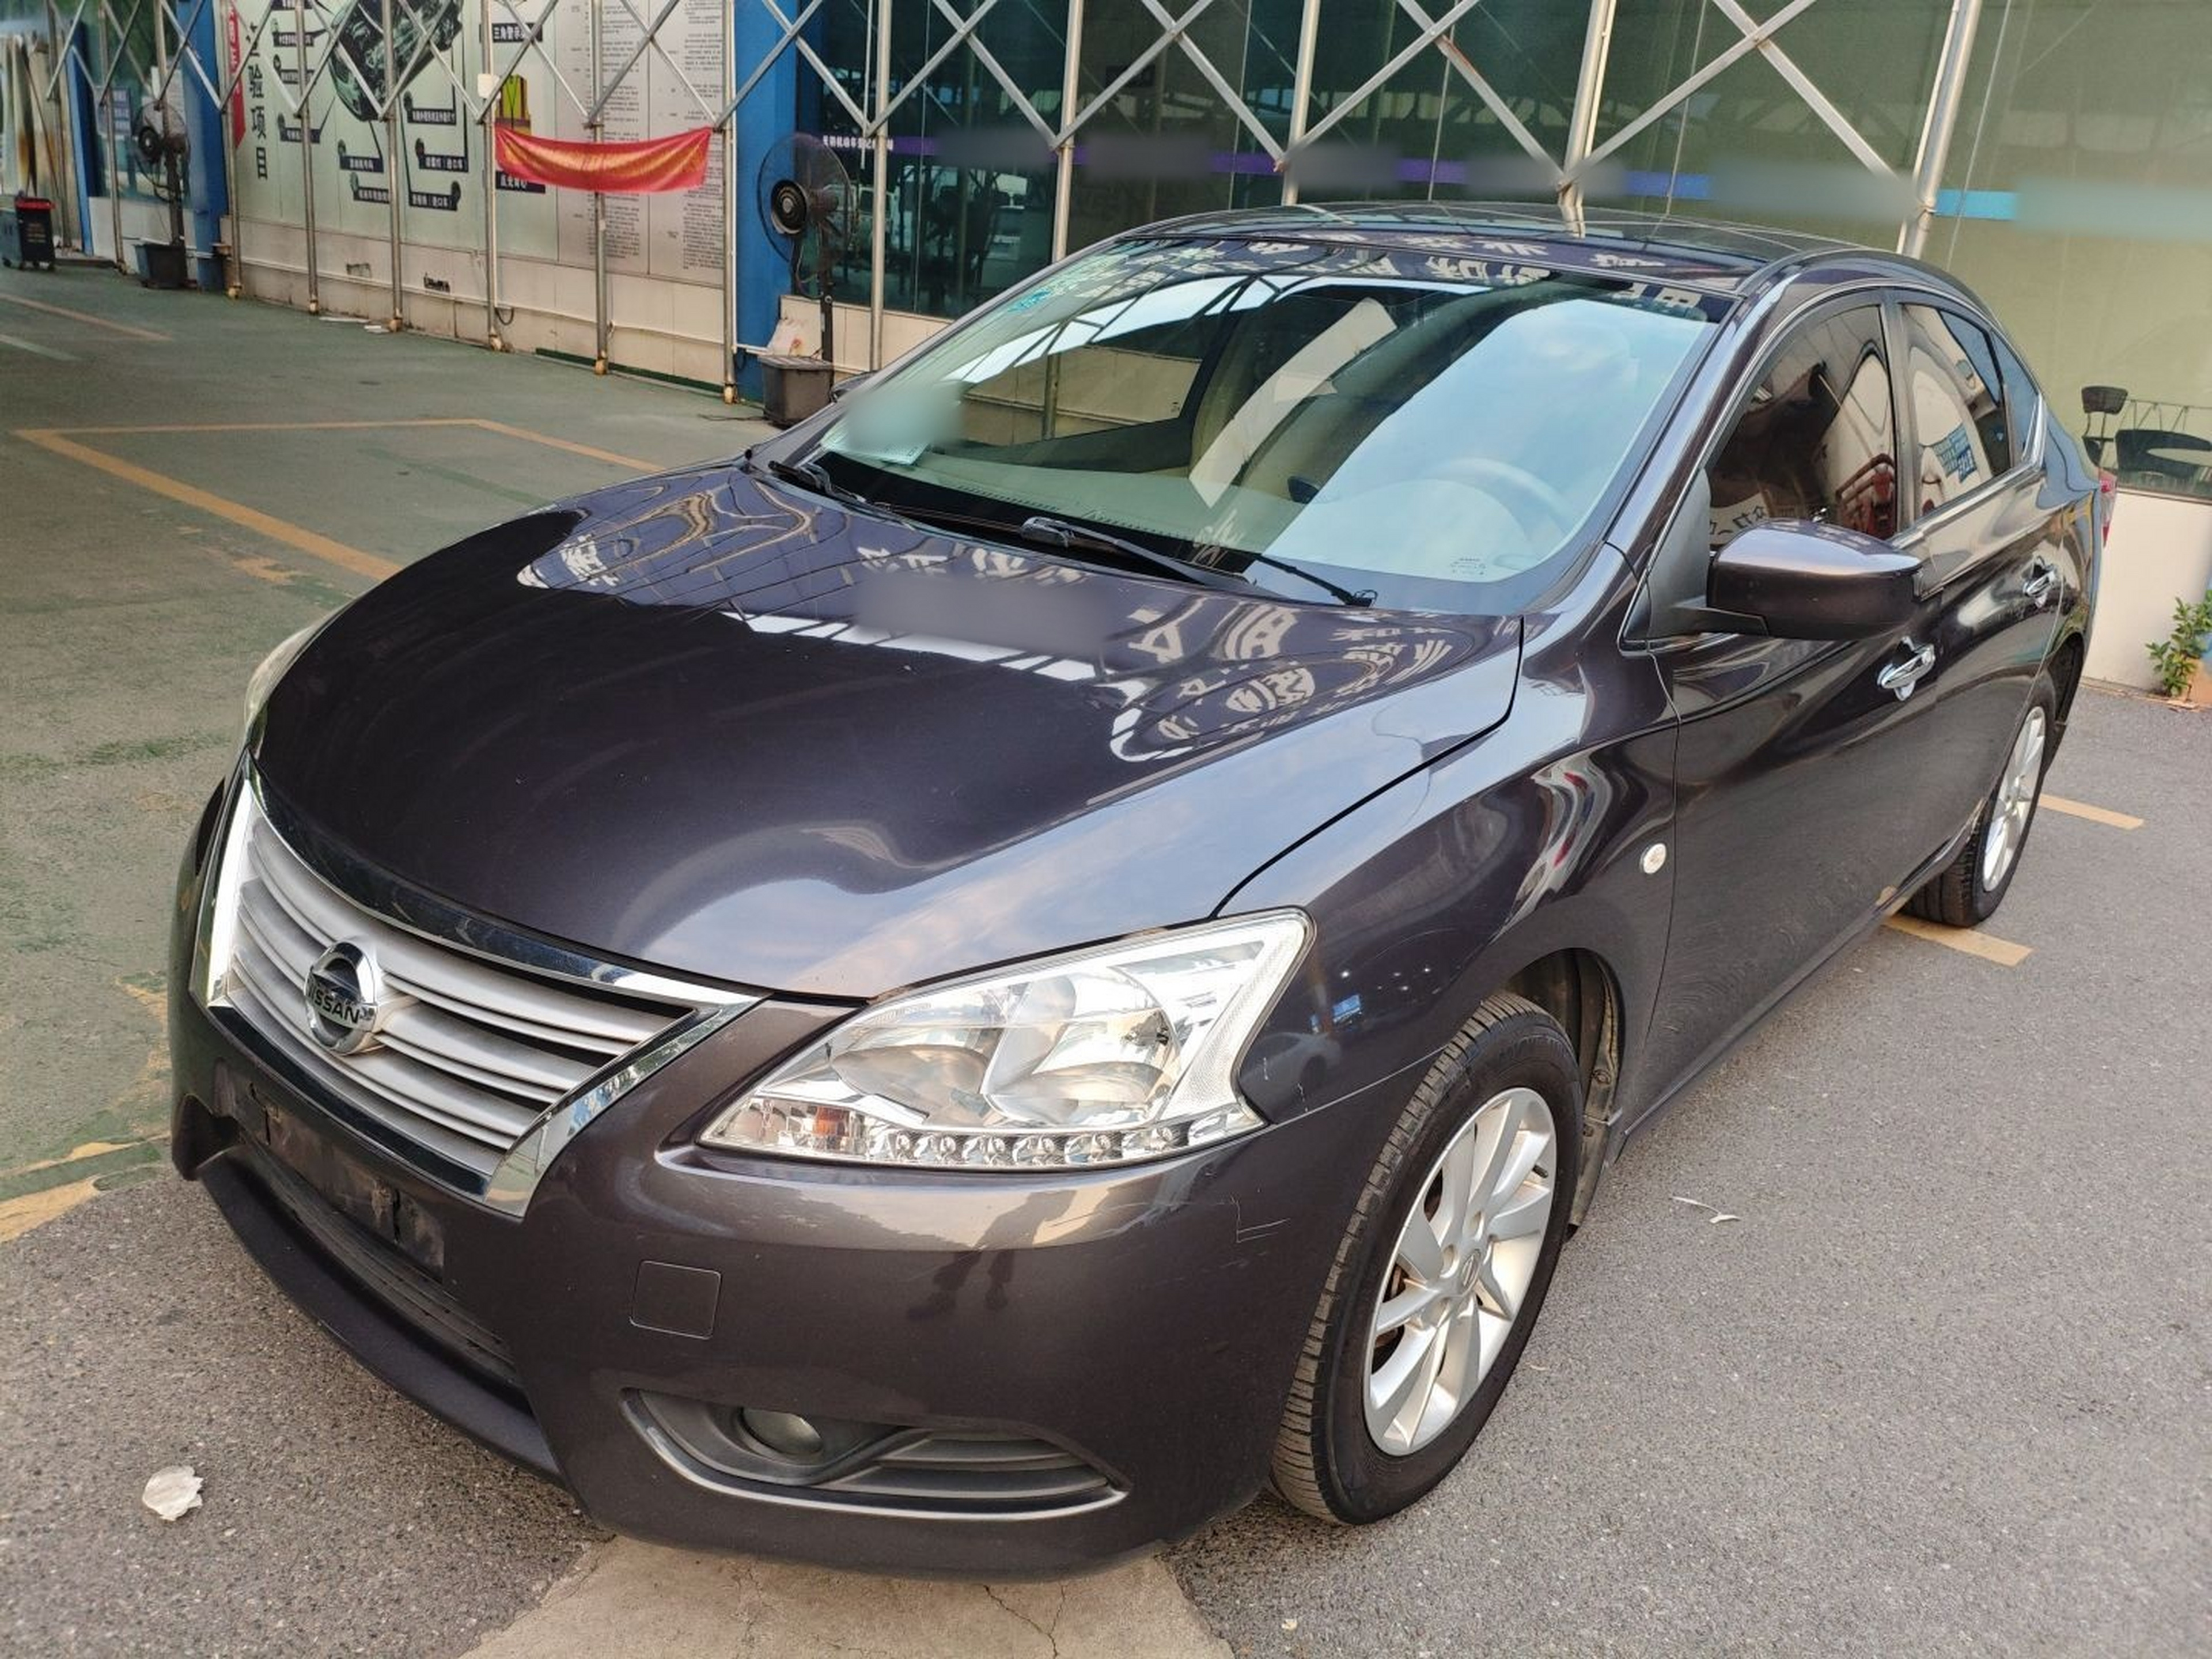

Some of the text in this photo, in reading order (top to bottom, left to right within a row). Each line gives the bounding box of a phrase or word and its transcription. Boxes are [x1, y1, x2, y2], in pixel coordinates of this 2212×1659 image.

[494, 25, 527, 40] 三角警示
[308, 982, 361, 1024] NISSAN
